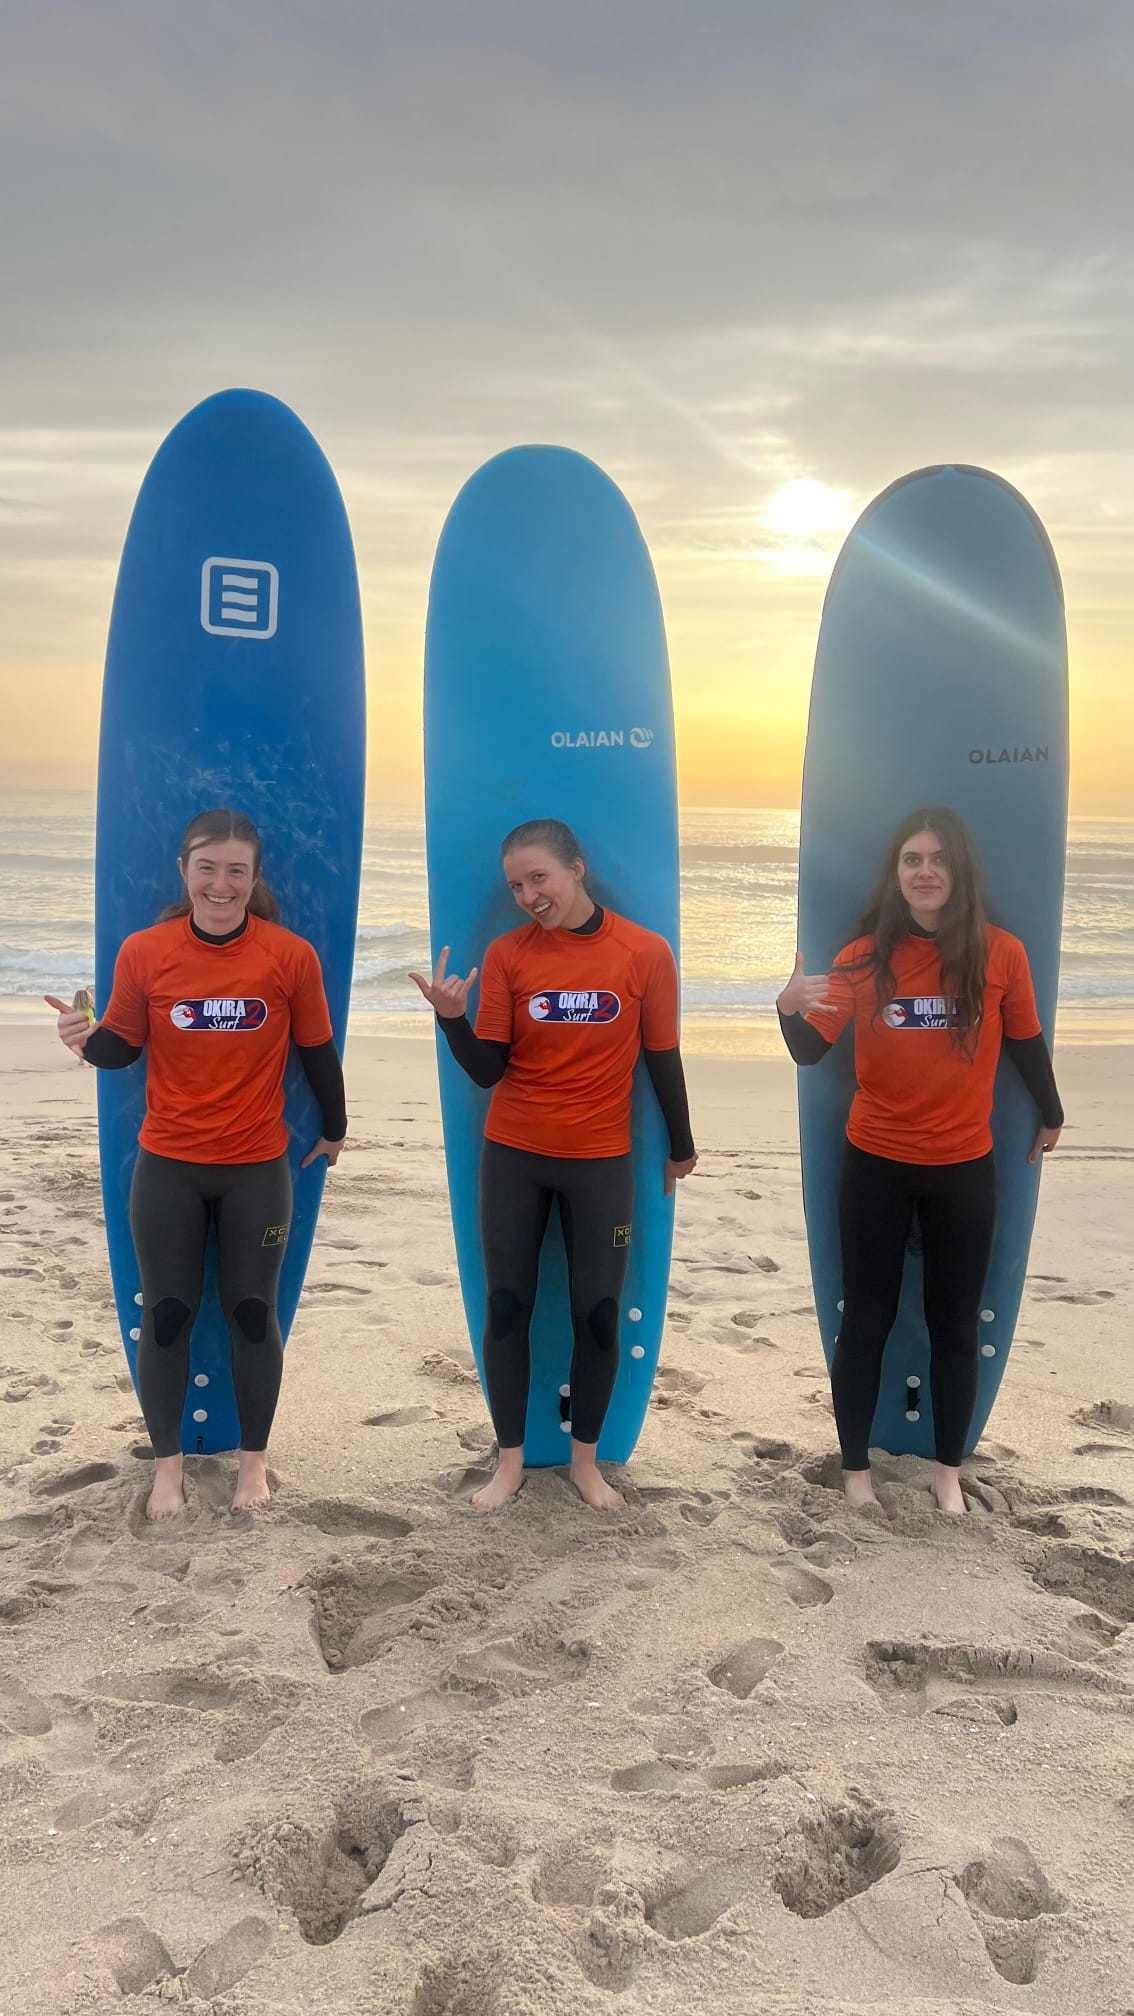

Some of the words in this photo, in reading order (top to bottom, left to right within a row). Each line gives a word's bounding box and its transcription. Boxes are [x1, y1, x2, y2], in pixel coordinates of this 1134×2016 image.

[551, 730, 624, 748] OLAIAN
[968, 745, 1049, 764] OLAIAN
[203, 999, 246, 1017] OKIRA
[242, 1001, 263, 1025] 2
[558, 992, 599, 1009] OKIRA
[594, 994, 615, 1019] 2
[208, 1015, 241, 1030] Surf
[562, 1008, 593, 1023] Surf
